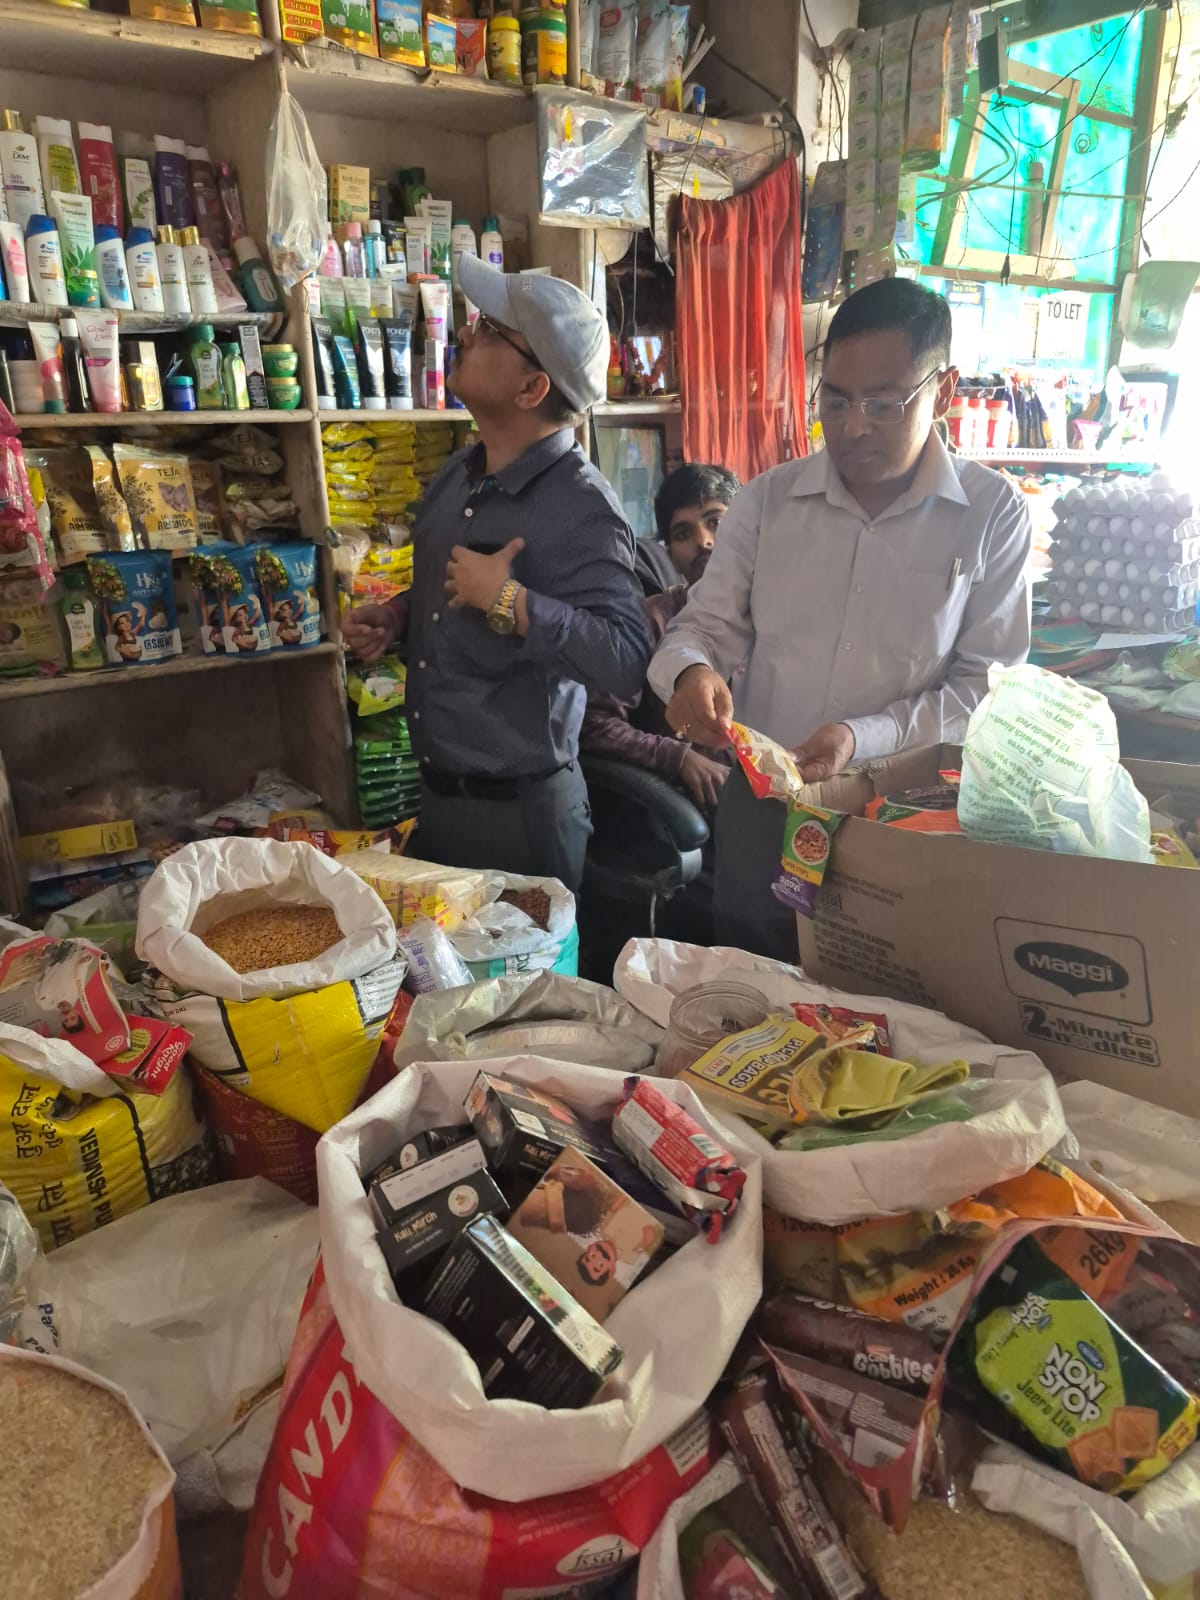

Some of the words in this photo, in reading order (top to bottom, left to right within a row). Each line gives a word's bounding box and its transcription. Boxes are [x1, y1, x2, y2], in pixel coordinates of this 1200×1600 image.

[1047, 301, 1062, 318] TO
[1064, 303, 1082, 320] LET
[1028, 952, 1113, 982] Maggi
[729, 1060, 766, 1088] BAGS
[853, 1352, 936, 1385] Gobbles
[1045, 1342, 1108, 1401] NON
[1016, 1380, 1051, 1417] Jeera
[1051, 1410, 1077, 1437] Lite
[1038, 1364, 1102, 1422] STOP
[262, 1345, 360, 1600] CAND
